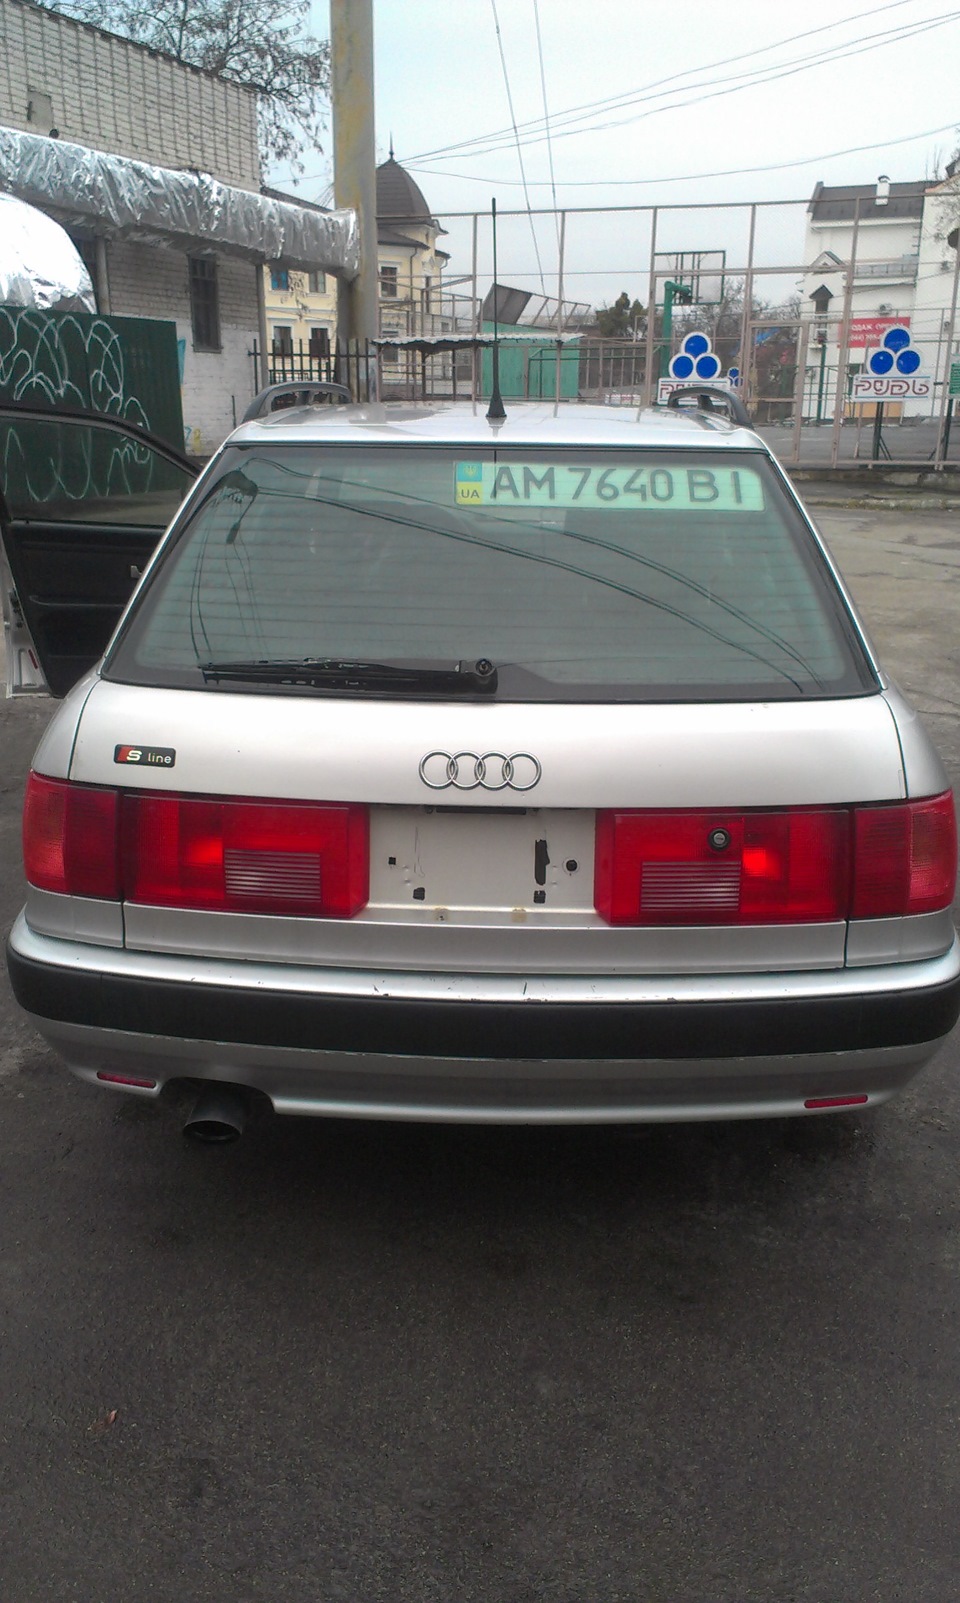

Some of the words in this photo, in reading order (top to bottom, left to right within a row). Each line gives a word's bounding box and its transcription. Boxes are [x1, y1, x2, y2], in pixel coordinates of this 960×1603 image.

[490, 466, 555, 500] AM
[567, 467, 674, 502] 7640
[688, 469, 743, 504] BI
[461, 489, 480, 499] UA
[126, 749, 143, 761] S
[147, 752, 172, 764] line
